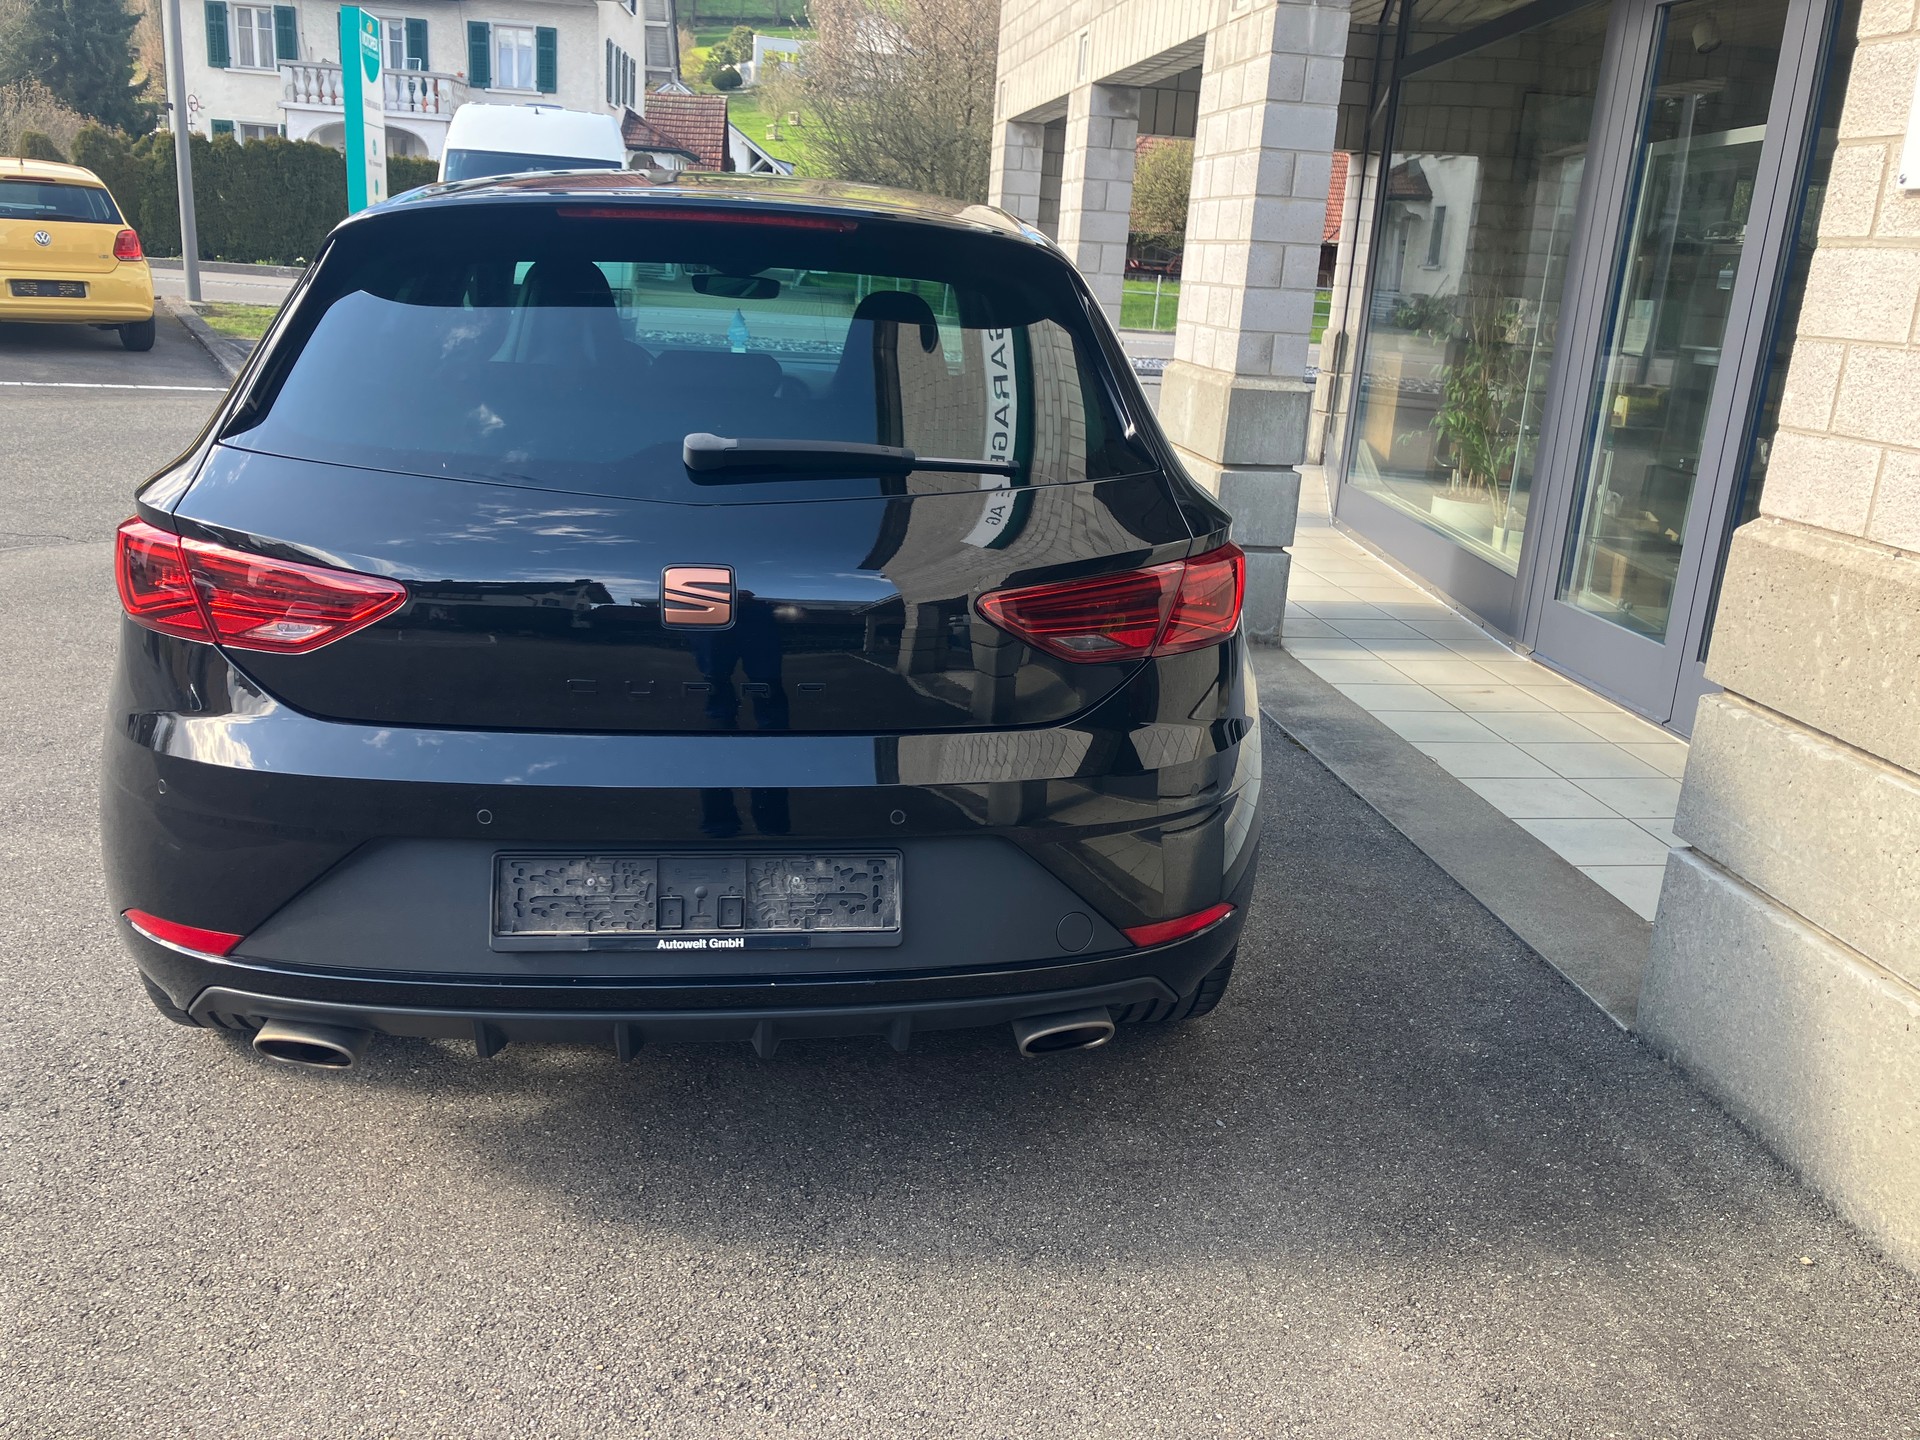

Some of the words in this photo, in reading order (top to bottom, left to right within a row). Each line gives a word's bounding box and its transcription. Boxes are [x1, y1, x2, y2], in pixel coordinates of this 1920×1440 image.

[567, 678, 827, 698] CUPRA
[657, 938, 707, 949] Autowelt
[709, 938, 745, 948] GmbH
